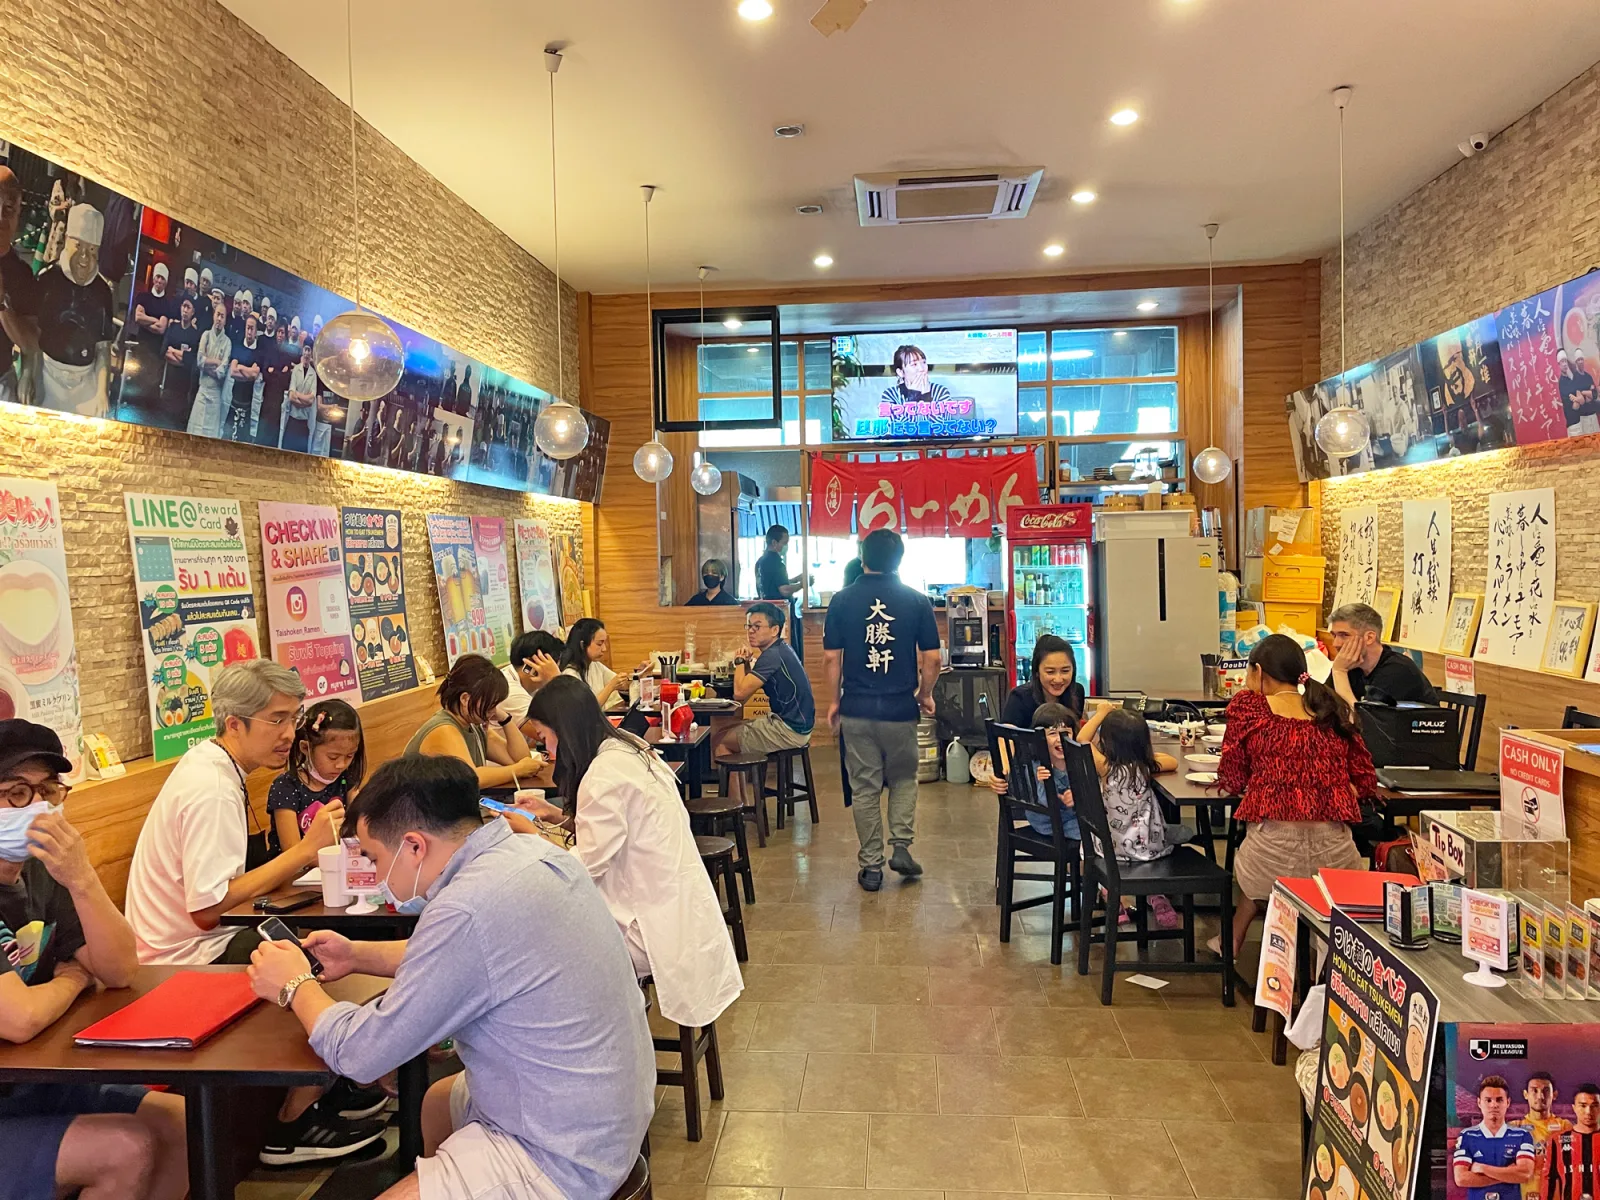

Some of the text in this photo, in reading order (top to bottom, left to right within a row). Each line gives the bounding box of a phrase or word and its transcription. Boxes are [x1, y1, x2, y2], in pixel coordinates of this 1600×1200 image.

[878, 400, 973, 416] 言ってないです
[130, 498, 197, 528] LINE@
[197, 503, 238, 515] Reward
[200, 517, 222, 529] Card
[265, 519, 333, 545] CHECK IN
[271, 545, 329, 569] & SHARE
[178, 567, 199, 590] รับ
[217, 565, 246, 588] แต้ม
[865, 598, 896, 674] 大勝軒
[319, 681, 326, 689] or
[1504, 744, 1559, 775] CASH ONLY
[1509, 768, 1551, 789] NO CREDIT CARDS
[1334, 926, 1407, 1008] つけ麺の食べ方
[1332, 952, 1403, 1028] HOW TO EAT TSUKEMEN
